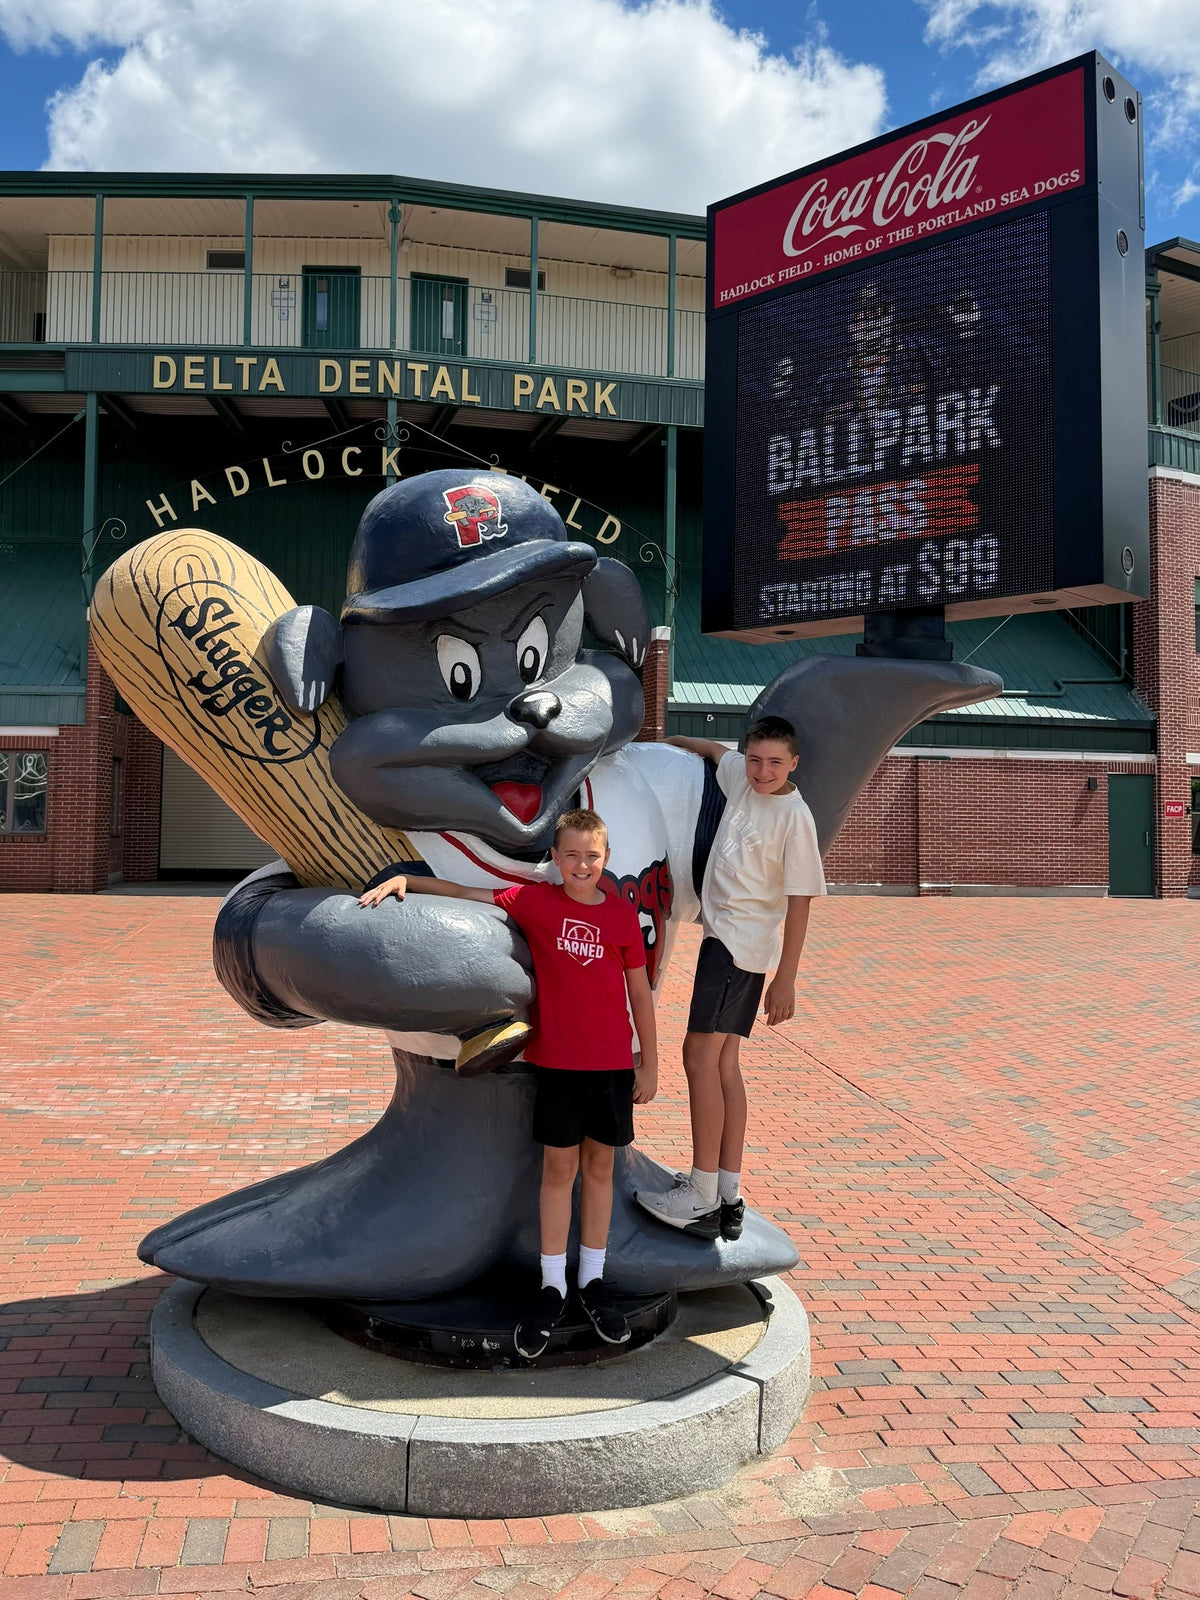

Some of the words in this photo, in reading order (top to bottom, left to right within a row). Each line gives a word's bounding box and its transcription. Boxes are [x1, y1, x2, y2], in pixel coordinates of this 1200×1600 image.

[783, 114, 992, 257] Coca-Cola
[719, 273, 775, 302] HADLOCK
[778, 260, 813, 282] FIELD
[824, 243, 862, 266] HOME
[865, 236, 883, 251] OF
[886, 225, 914, 245] THE
[917, 198, 996, 234] PORTLAND
[1000, 187, 1030, 206] SEA
[1034, 169, 1080, 196] DOGS
[153, 355, 286, 392] DELTA
[319, 359, 480, 404] DENTAL
[513, 373, 617, 416] PARK
[768, 384, 1001, 496] BALLPARK
[146, 446, 402, 528] HADLOCK
[826, 478, 928, 550] PASS
[878, 563, 912, 603] AT
[1166, 805, 1182, 813] FACP
[556, 937, 605, 959] EARNED
